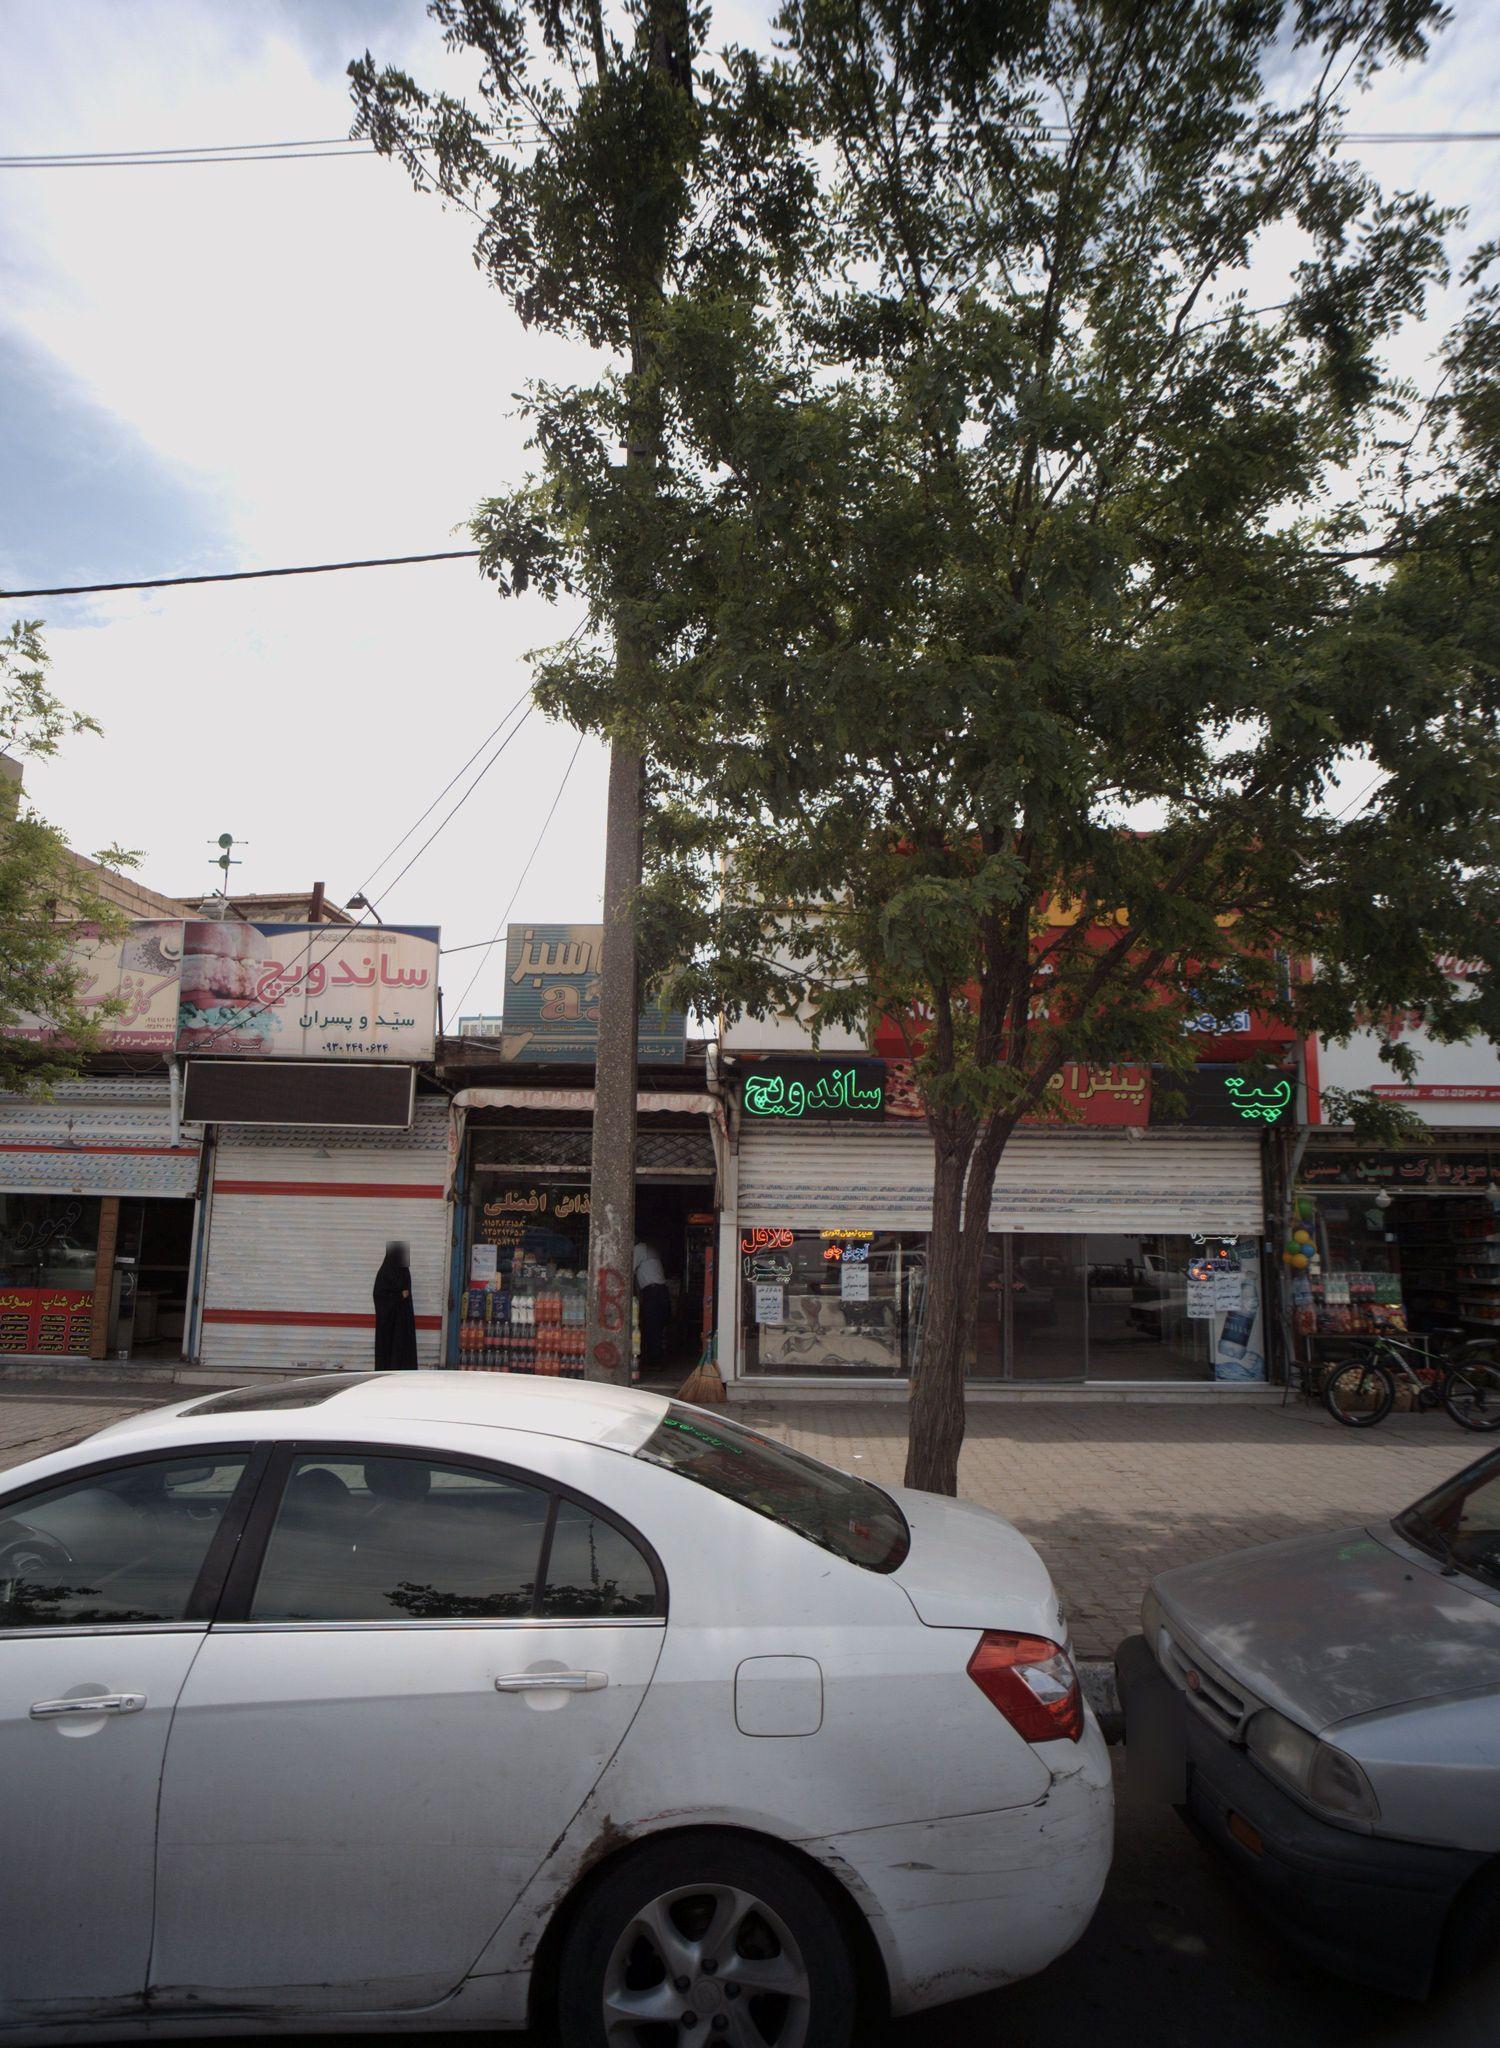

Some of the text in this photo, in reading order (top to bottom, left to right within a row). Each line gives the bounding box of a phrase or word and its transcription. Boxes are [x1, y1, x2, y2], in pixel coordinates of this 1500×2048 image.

[256, 953, 428, 1006] ساندویچ
[299, 1010, 352, 1031] پسران
[359, 1015, 368, 1030] و
[745, 1069, 882, 1117] ساندویچ
[483, 1189, 547, 1216] افضلی
